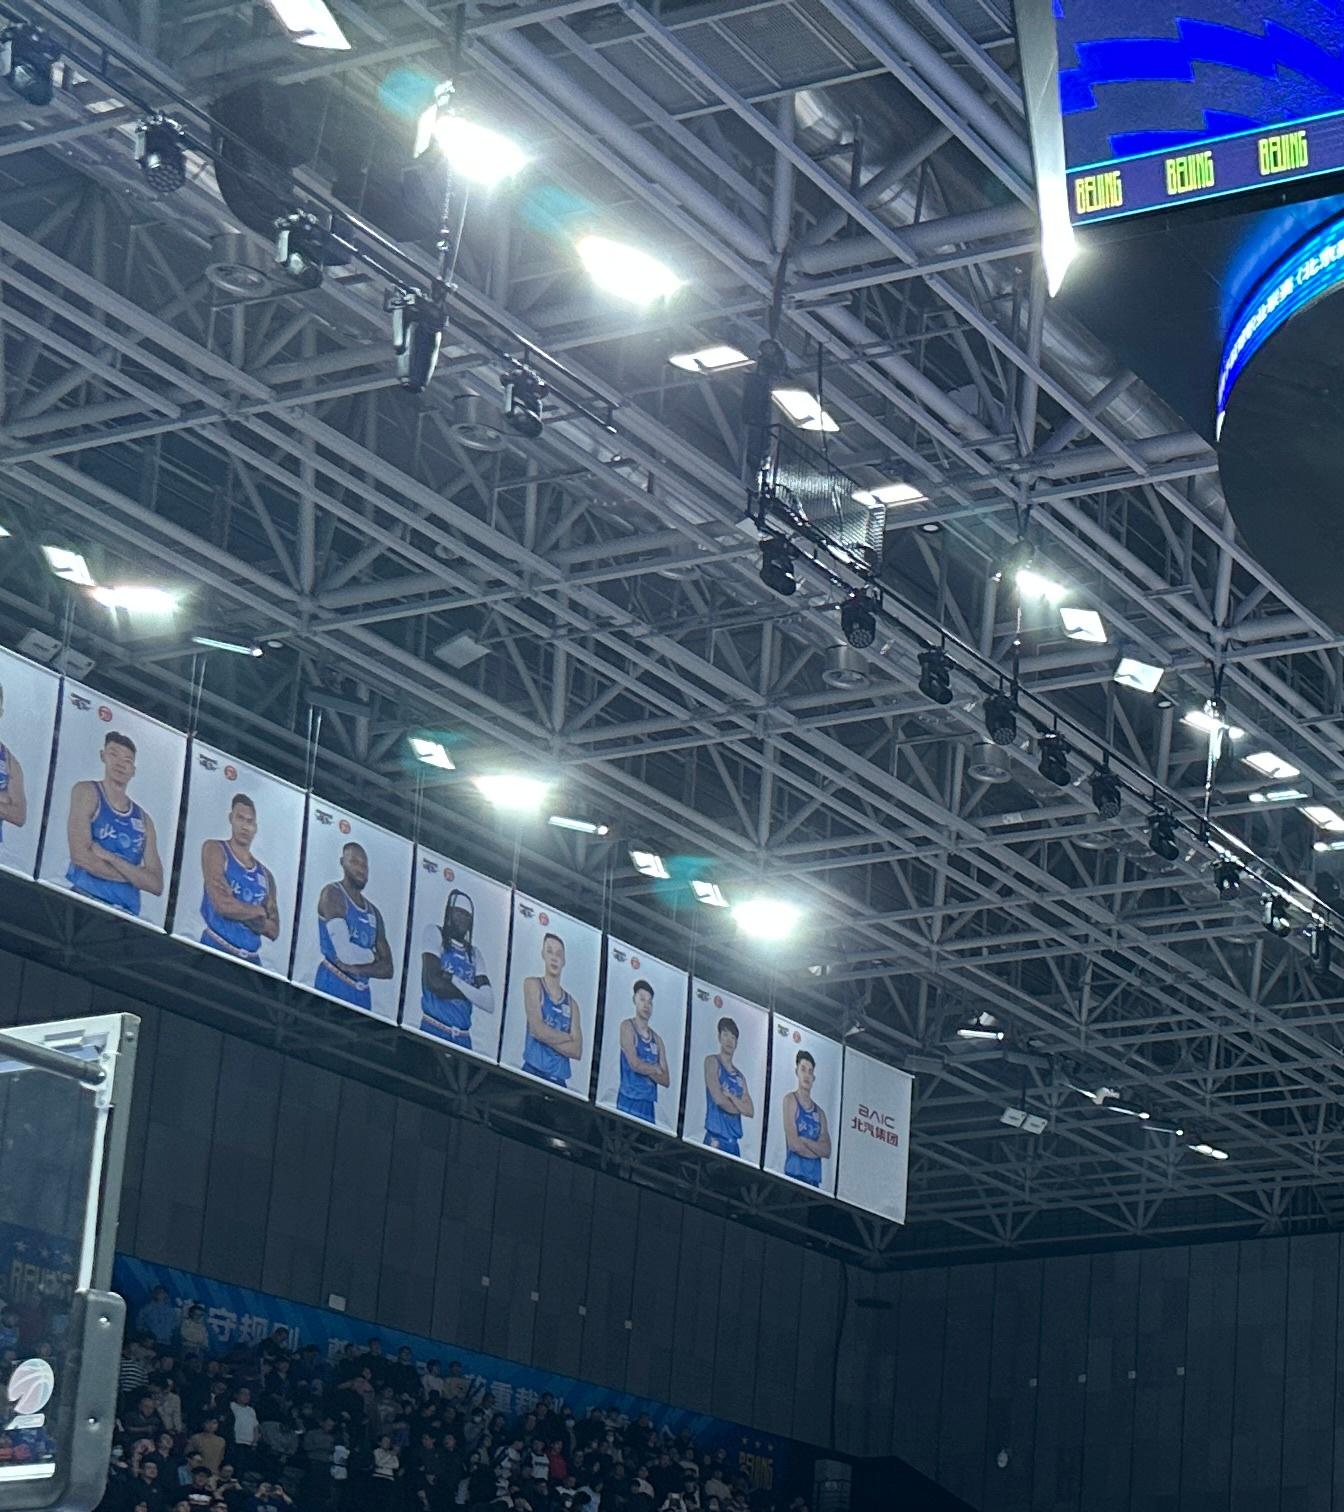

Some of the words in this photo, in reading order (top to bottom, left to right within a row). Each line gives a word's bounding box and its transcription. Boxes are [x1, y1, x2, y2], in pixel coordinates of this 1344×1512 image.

[1167, 151, 1215, 195] BEIJING
[1259, 130, 1309, 175] BEIJING
[1075, 170, 1122, 215] BEIJING
[851, 1117, 899, 1147] 北汽集团
[858, 1104, 895, 1129] BAIC
